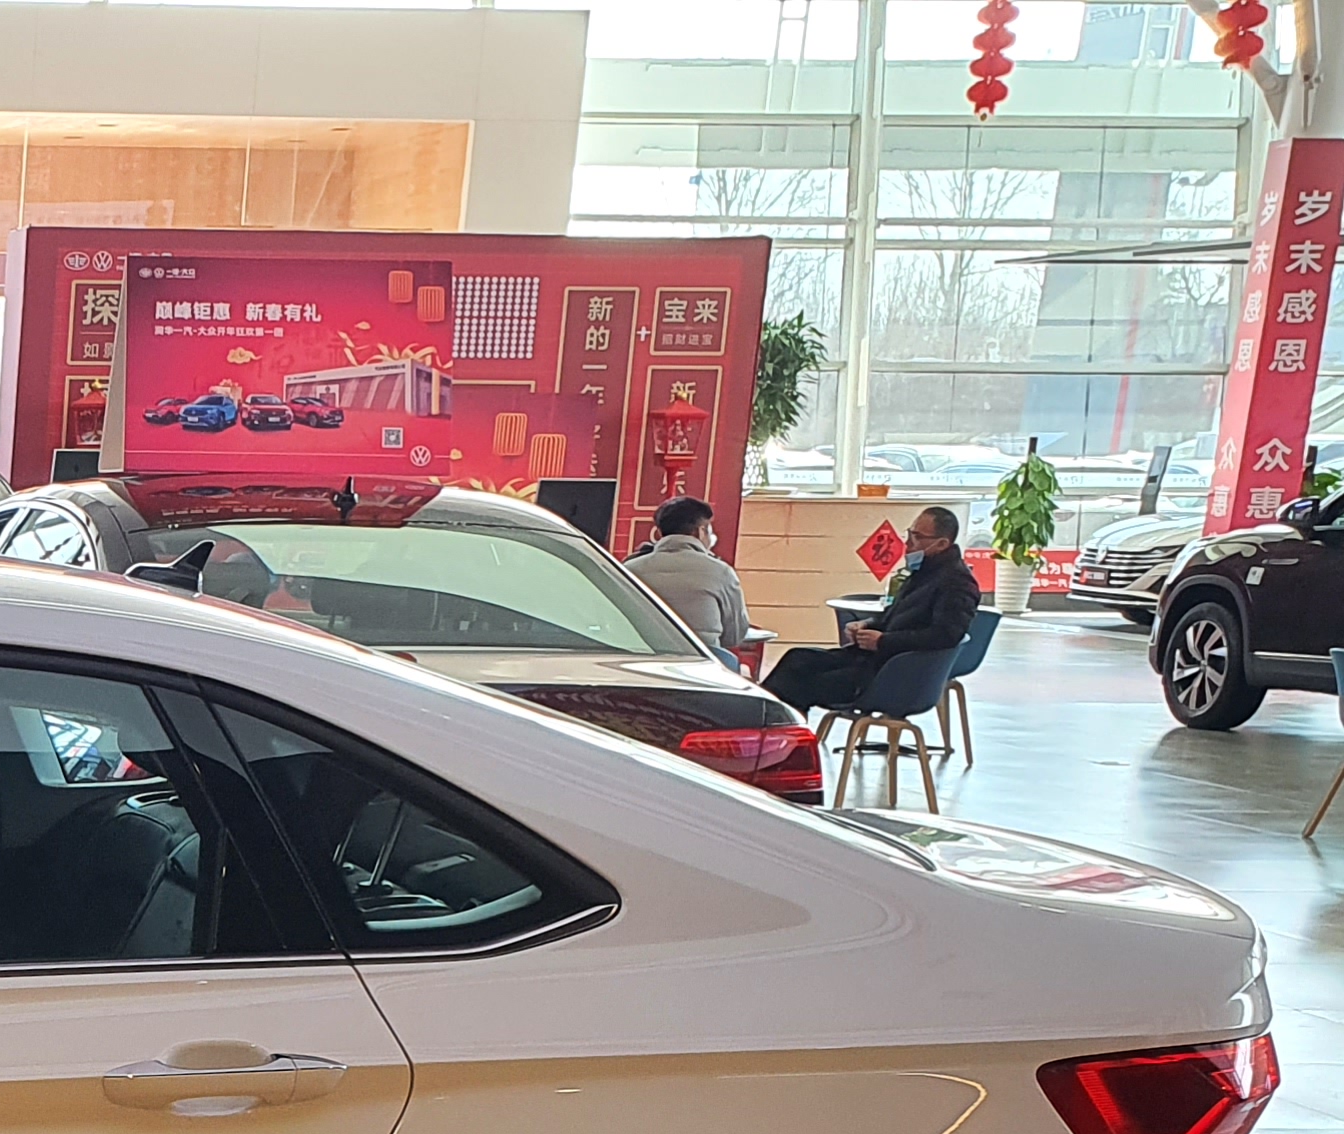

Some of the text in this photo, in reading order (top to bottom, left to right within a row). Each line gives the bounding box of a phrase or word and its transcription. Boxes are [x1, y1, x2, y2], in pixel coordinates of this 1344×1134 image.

[155, 301, 322, 322] 巅峰钜惠 新春有礼
[662, 297, 719, 323] 宝来
[1234, 190, 1280, 373] 岁末感恩
[1268, 189, 1334, 373] 岁末感恩
